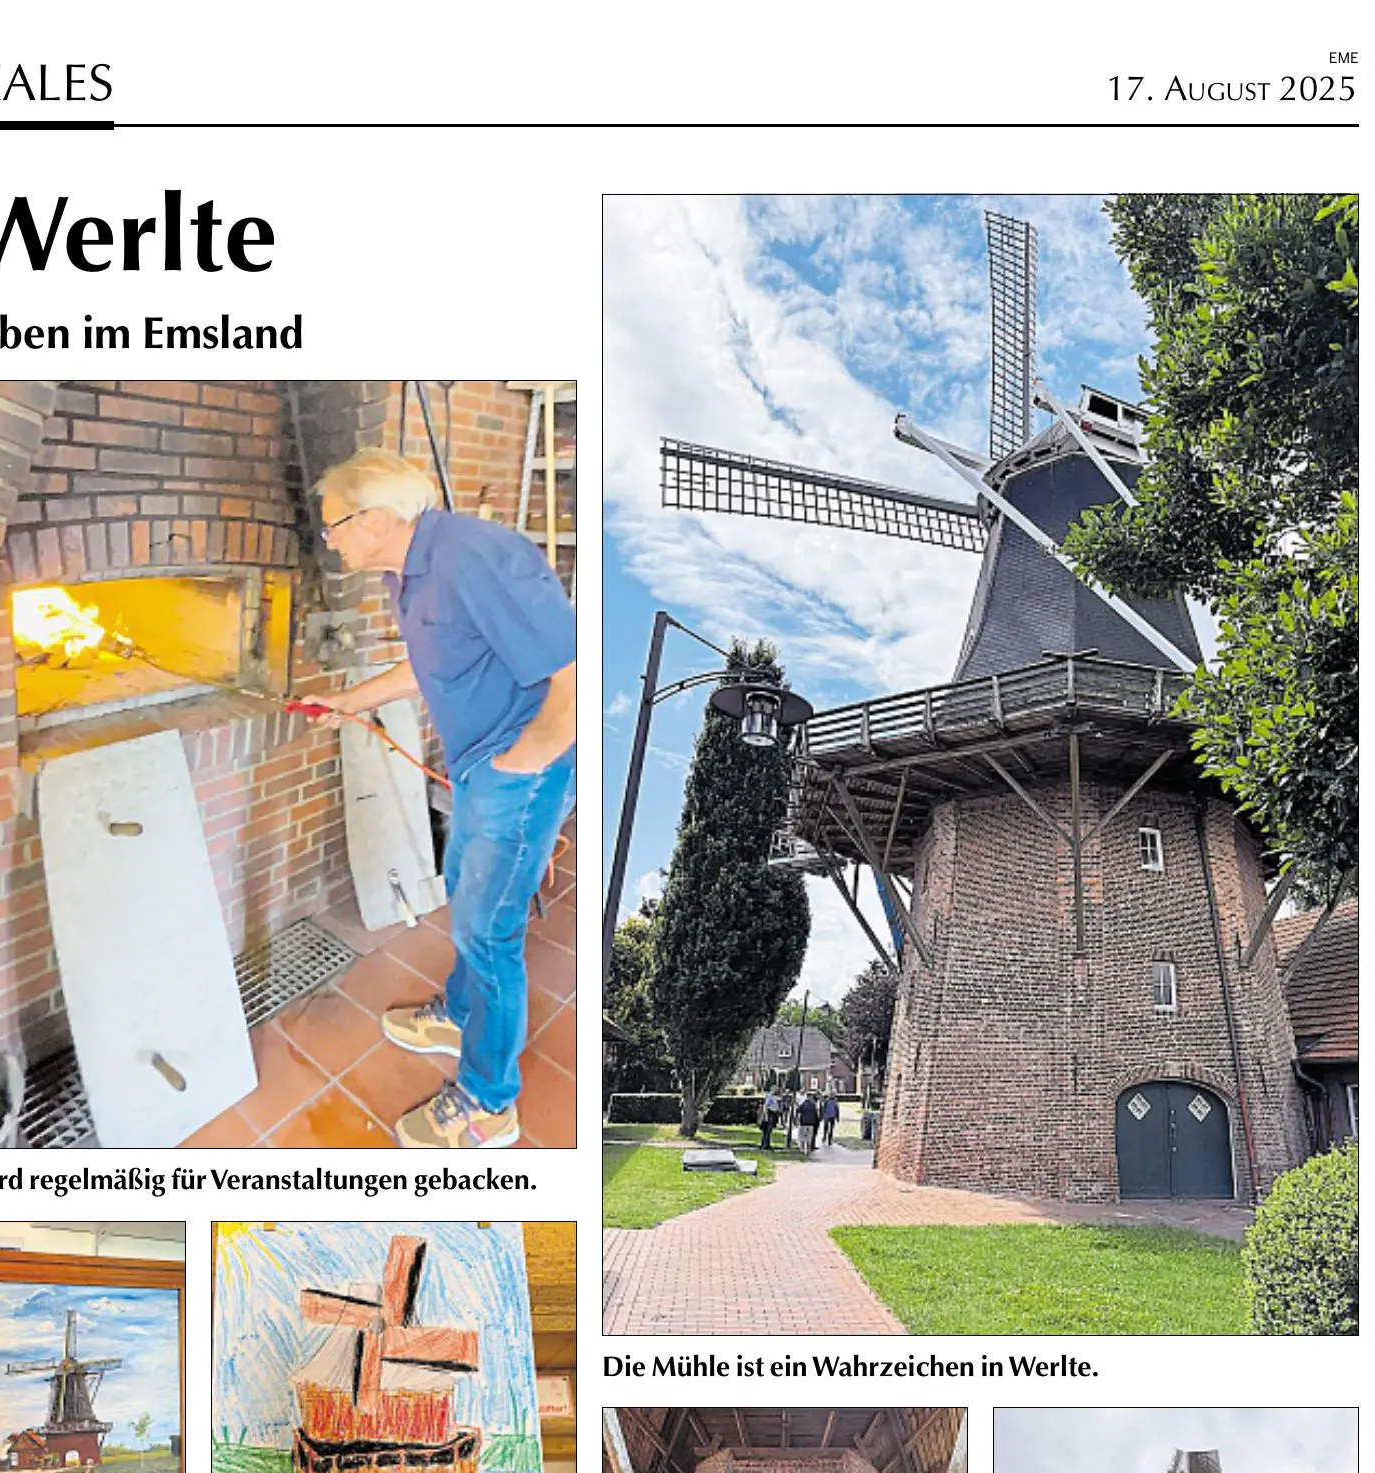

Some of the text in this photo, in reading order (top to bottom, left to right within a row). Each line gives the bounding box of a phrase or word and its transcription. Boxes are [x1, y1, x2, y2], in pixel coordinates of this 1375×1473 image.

[1329, 51, 1359, 64] EME
[1109, 75, 1153, 101] 17.
[1279, 75, 1355, 102] 2025
[84, 314, 130, 349] im
[144, 313, 303, 350] Emsland
[29, 1167, 166, 1198] regelmäßig
[170, 1167, 207, 1191] für
[210, 1167, 408, 1198] Veranstaltungen
[413, 1167, 537, 1198] gebacken.
[603, 1354, 1099, 1378] Die Mühle ist ein Wahrzeichen in Werlte.
